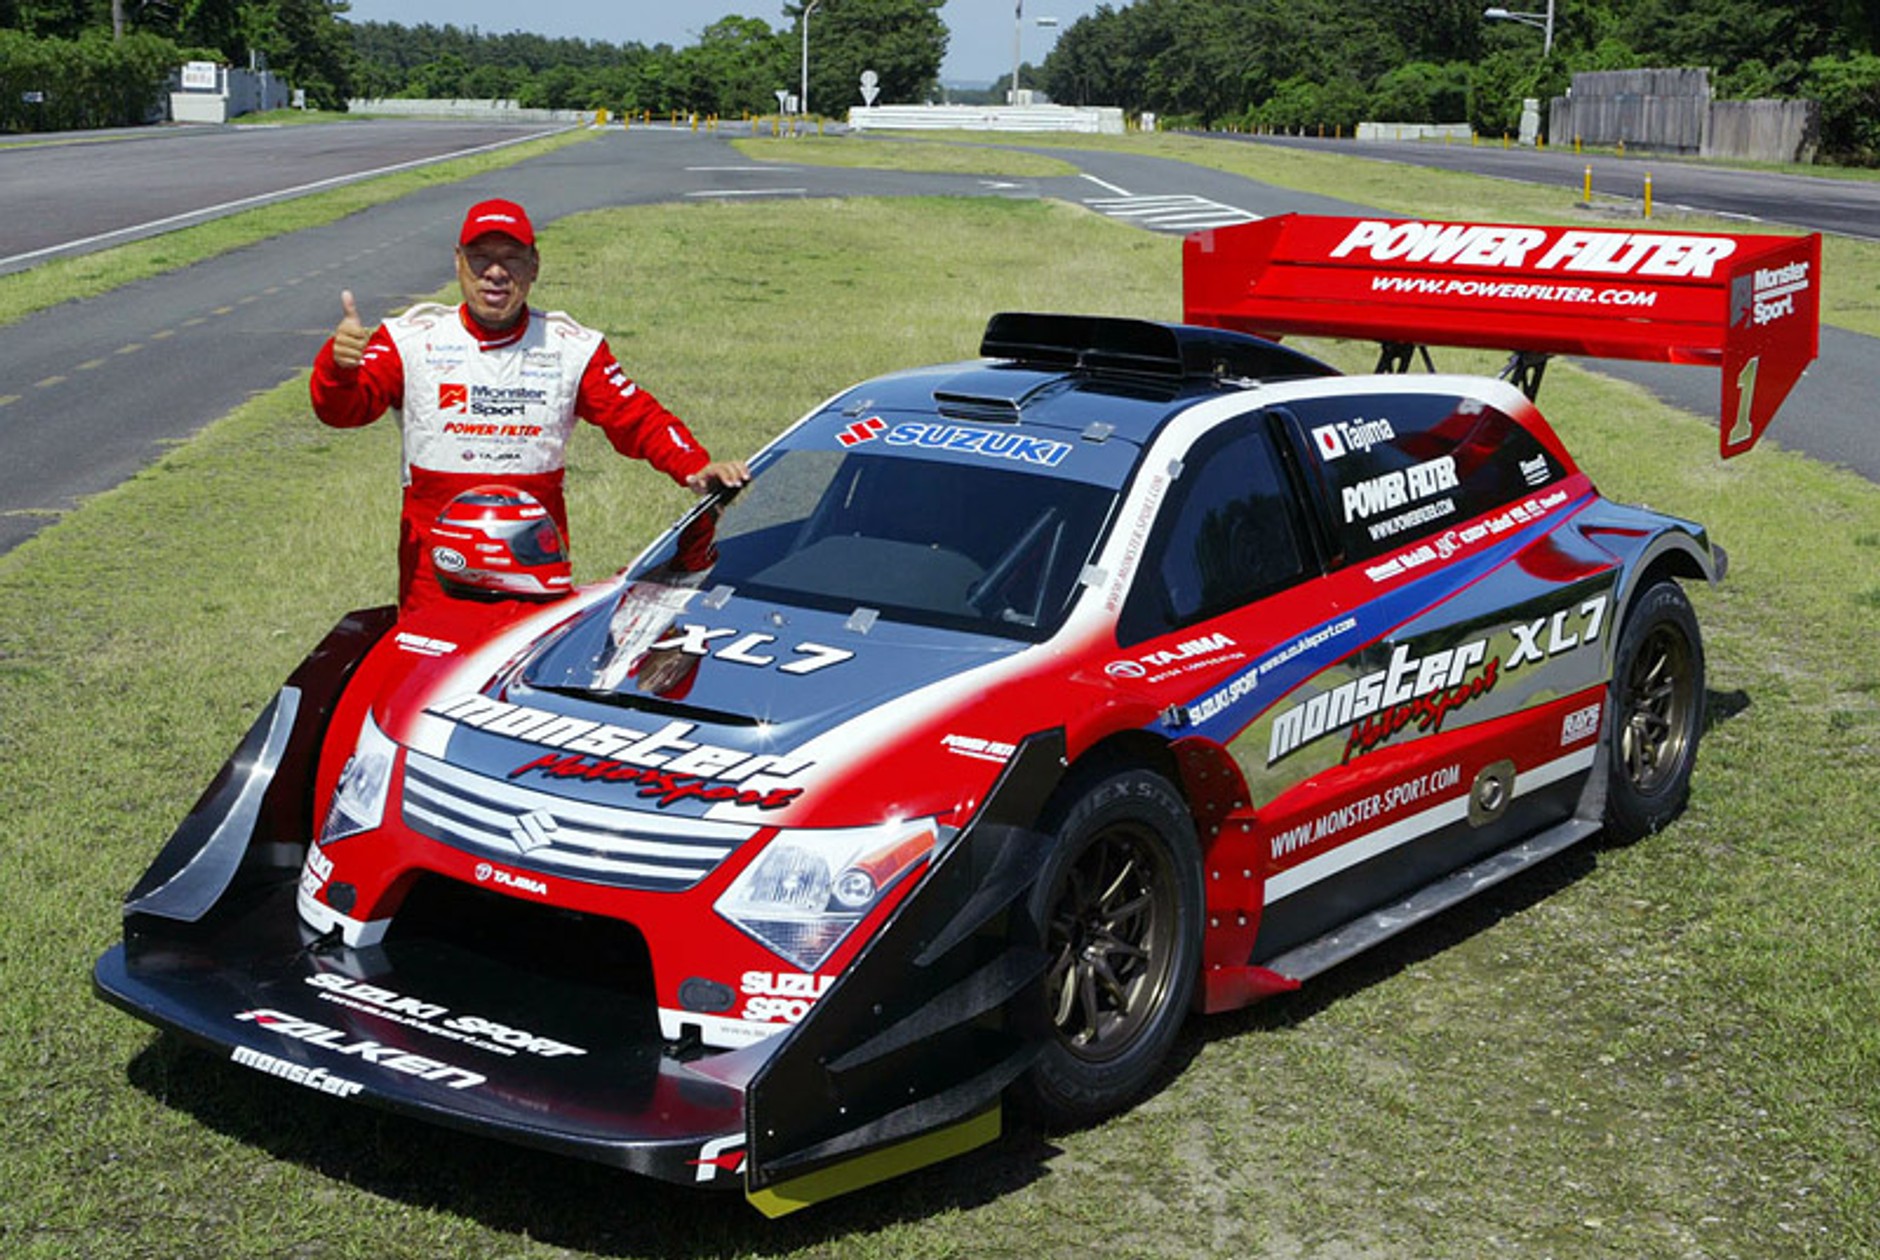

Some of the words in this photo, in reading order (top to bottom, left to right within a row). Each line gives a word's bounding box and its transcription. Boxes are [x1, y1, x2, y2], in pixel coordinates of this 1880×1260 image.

[1330, 221, 1546, 268] POWER
[1535, 230, 1737, 278] FILTER
[1371, 276, 1658, 308] WWW.POWERFILTER.COM
[1753, 261, 1809, 291] Monster
[1753, 294, 1794, 325] Sport
[471, 386, 547, 399] Monster
[471, 403, 526, 417] Sport
[1727, 356, 1760, 446] 1
[443, 422, 499, 434] POWER
[500, 425, 543, 436] FILTER
[884, 420, 1073, 467] SUZUKI
[1337, 417, 1395, 453] Tajima
[1342, 471, 1408, 524] POWER
[1406, 455, 1460, 501] FILTER
[650, 623, 855, 676] XL7
[1140, 632, 1236, 666] TAJIMA
[1504, 595, 1606, 671] XL7
[1266, 637, 1487, 766] monster
[424, 693, 816, 781] monster
[1270, 765, 1460, 859] WWW.MONSTER-SPORT.COM
[493, 868, 547, 895] TAJIMA
[305, 973, 449, 1019] SUZUKI
[443, 1016, 588, 1056] SPORT
[230, 1045, 364, 1097] monster
[234, 1008, 487, 1089] FALKEN
